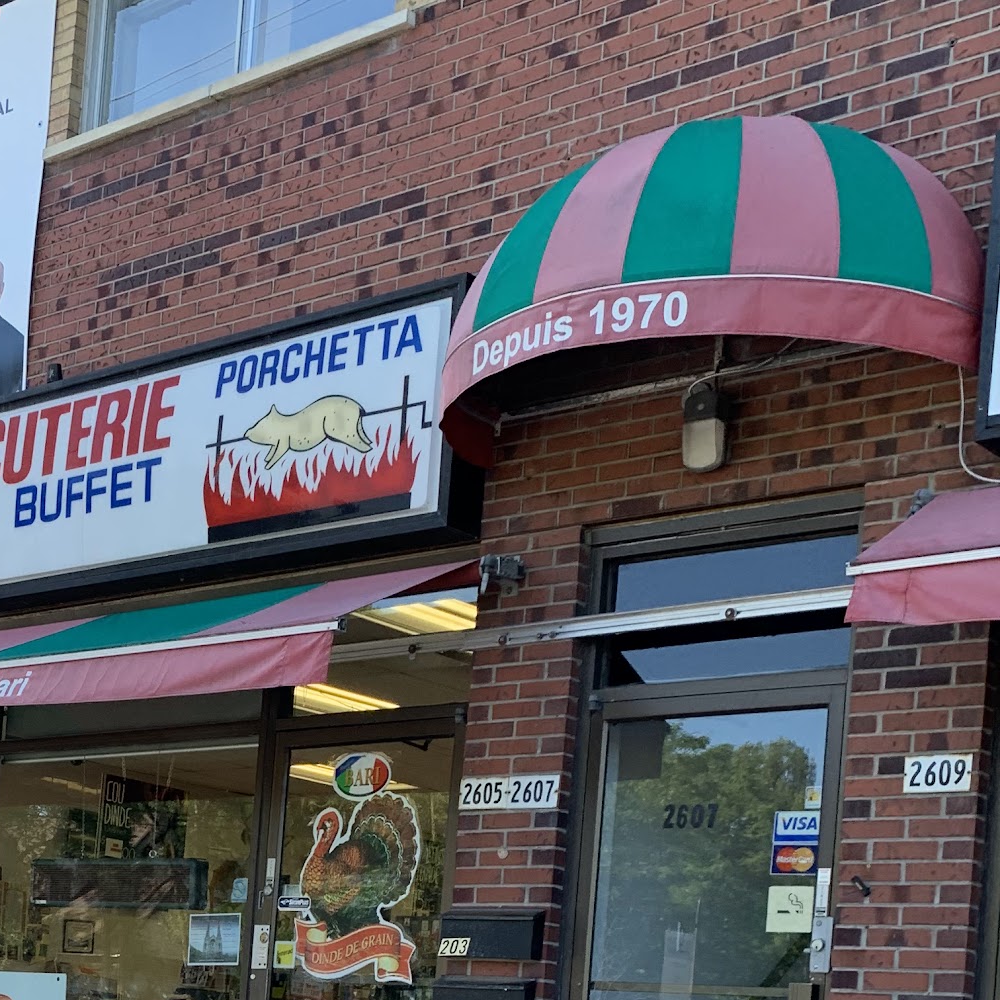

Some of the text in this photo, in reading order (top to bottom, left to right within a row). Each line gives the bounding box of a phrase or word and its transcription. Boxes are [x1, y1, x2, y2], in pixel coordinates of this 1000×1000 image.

[472, 290, 688, 376] Depuis 1970
[215, 314, 423, 398] PORCHETTA
[14, 457, 162, 528] BUFFET
[344, 767, 381, 788] BARI
[909, 759, 967, 787] 2609
[106, 780, 126, 804] COU
[104, 803, 132, 829] DINDE
[663, 803, 718, 829] 2607
[782, 817, 817, 830] VISA
[311, 948, 344, 965] DINDE
[345, 941, 360, 958] DE
[361, 933, 395, 950] GRAIN
[440, 939, 468, 955] 203
